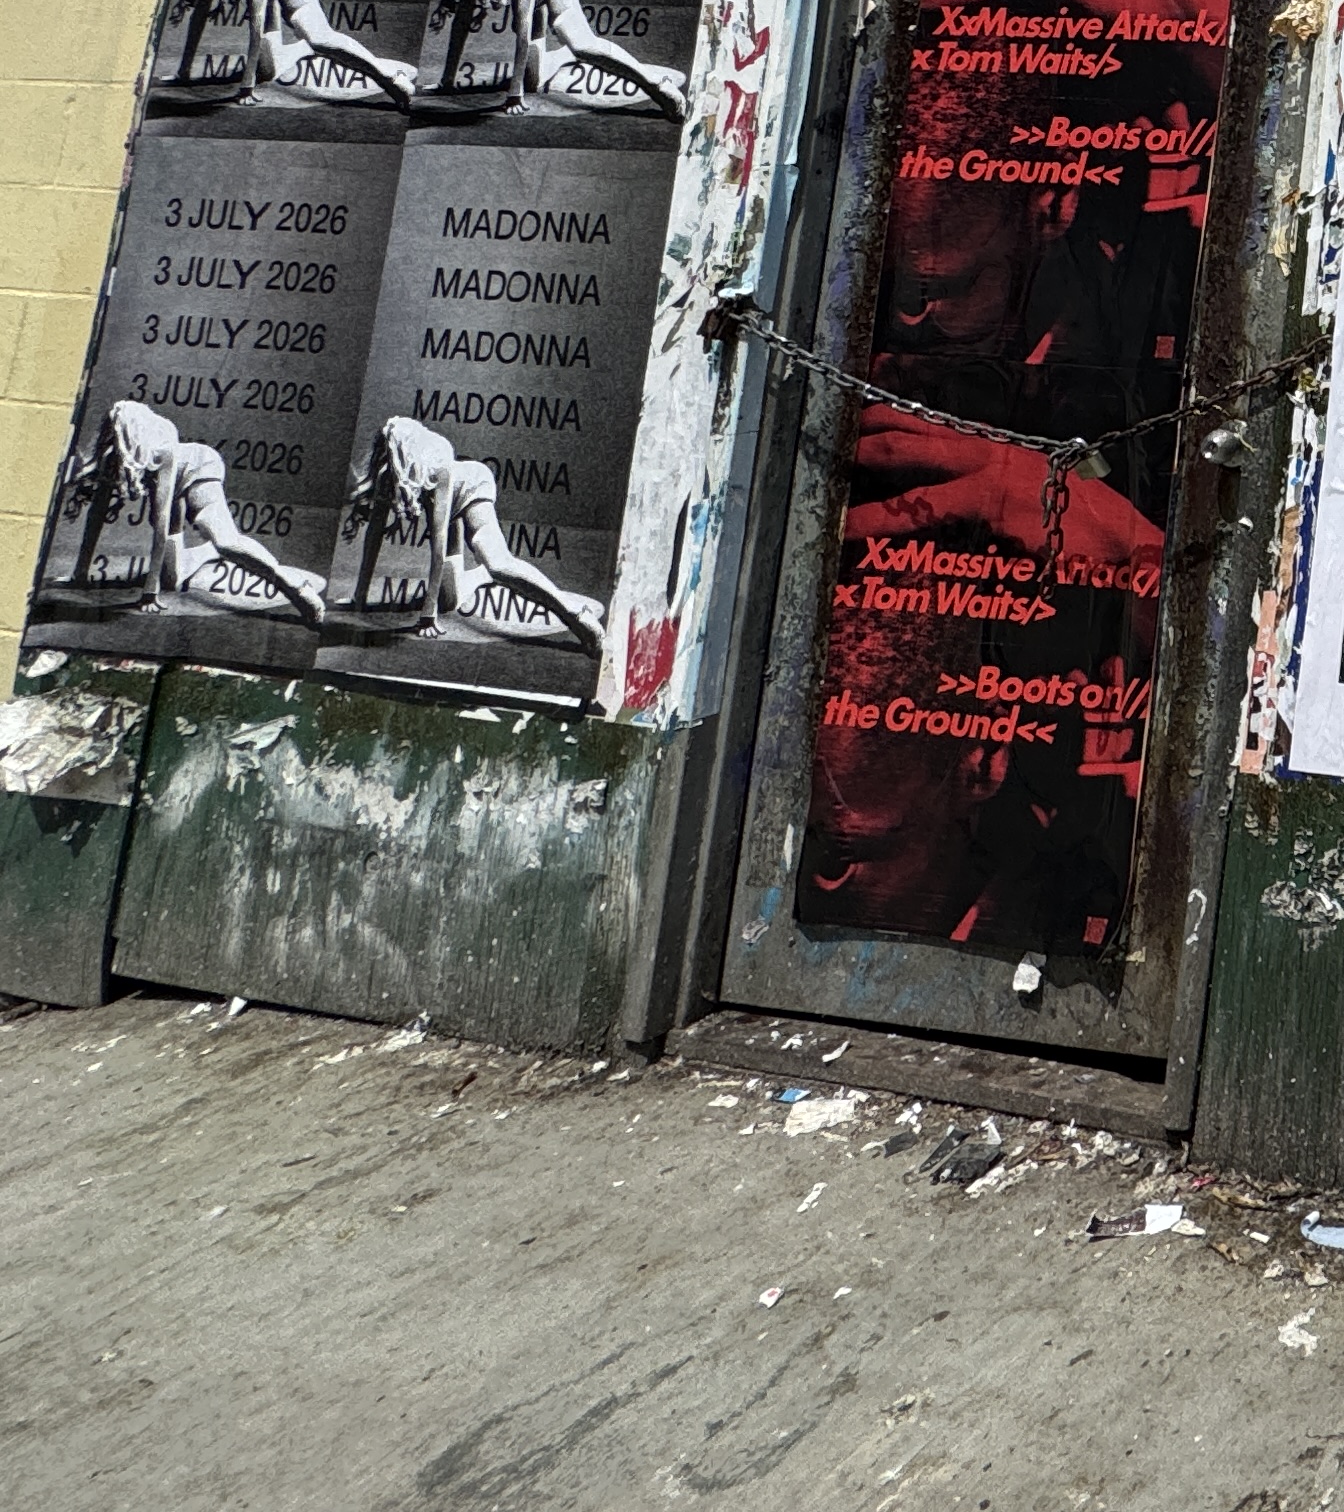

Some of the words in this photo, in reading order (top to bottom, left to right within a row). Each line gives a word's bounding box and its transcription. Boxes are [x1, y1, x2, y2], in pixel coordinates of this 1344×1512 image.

[933, 6, 1103, 39] XxMassive
[938, 42, 1002, 72] Tom
[1010, 116, 1141, 149] >>Boots
[900, 145, 954, 179] the
[959, 150, 1124, 185] Ground<<
[165, 198, 181, 228] 3
[188, 199, 271, 231] JULY
[275, 201, 348, 235] 2026
[442, 207, 610, 244] MADONNA
[154, 256, 171, 285] 3
[177, 258, 260, 288] JULY
[268, 260, 336, 293] 2026
[431, 267, 600, 306] MADONNA
[143, 314, 160, 343] 3
[165, 315, 249, 348] JULY
[256, 320, 326, 353] 2026
[421, 328, 590, 368] MADONNA
[128, 374, 148, 401] 3
[154, 375, 239, 408] JULY
[243, 379, 315, 414] 2026
[413, 389, 581, 431] MADONNA
[232, 440, 304, 474] 2026
[856, 536, 1034, 582] XxMassive
[862, 576, 930, 613] Tom
[936, 666, 1077, 706] >>Boots
[824, 690, 879, 728] the
[886, 696, 1058, 744] Ground<<
